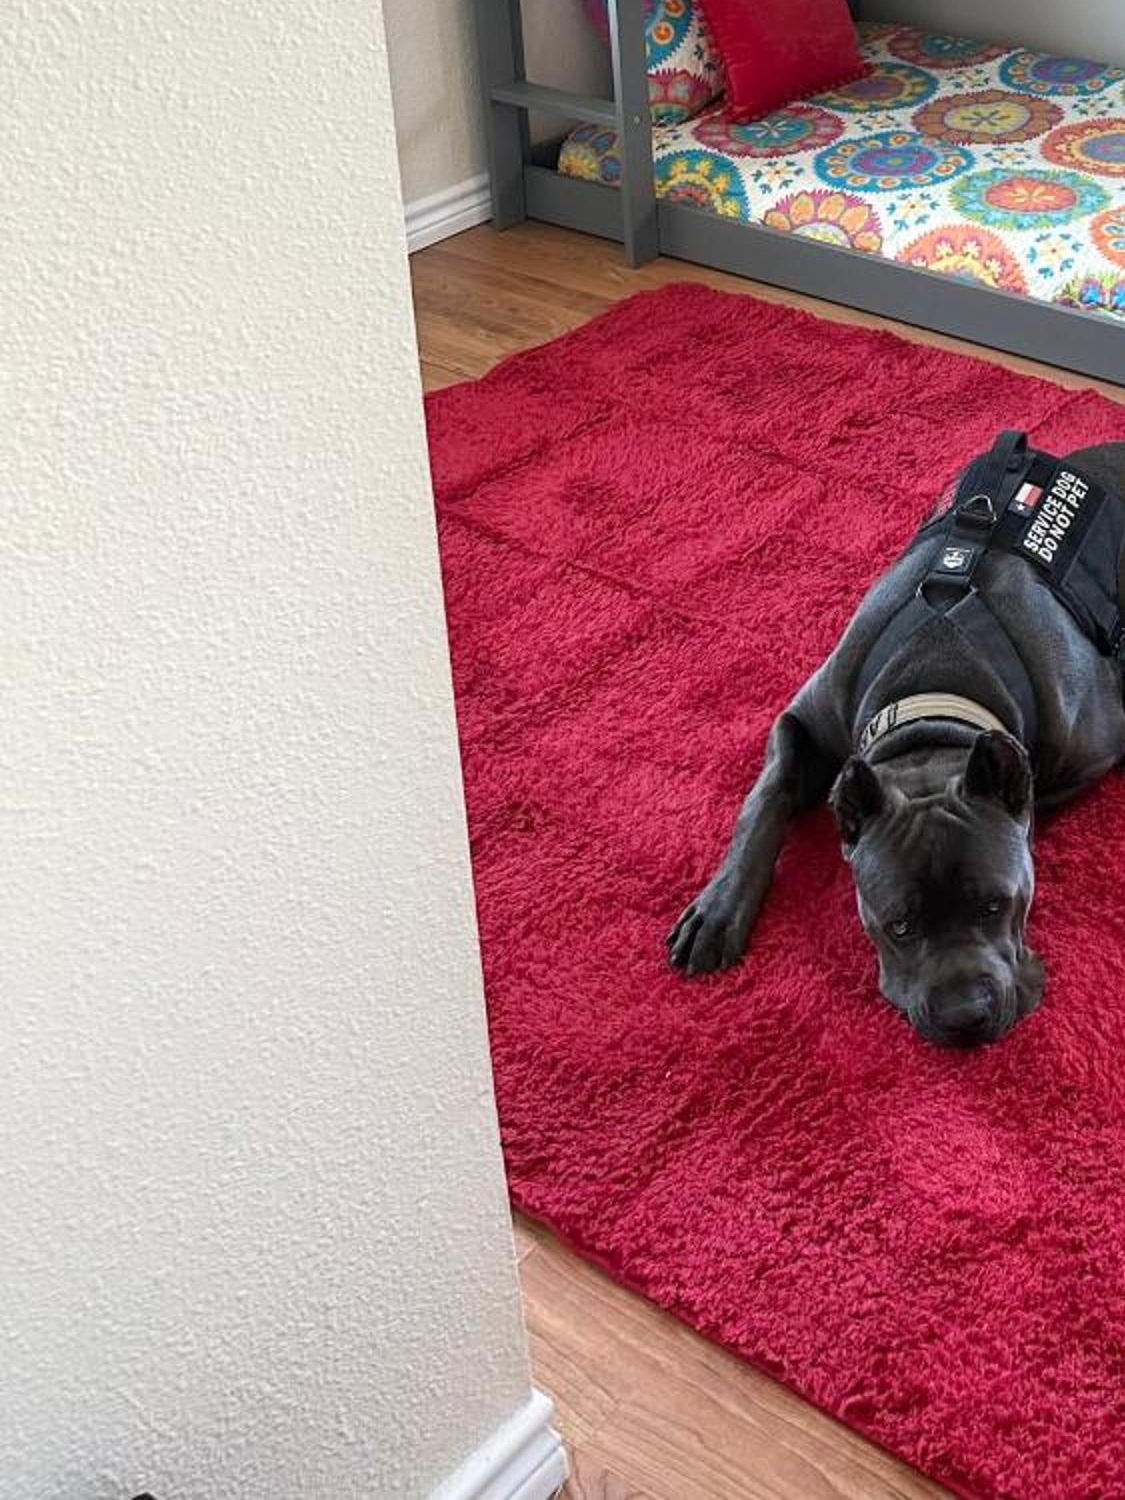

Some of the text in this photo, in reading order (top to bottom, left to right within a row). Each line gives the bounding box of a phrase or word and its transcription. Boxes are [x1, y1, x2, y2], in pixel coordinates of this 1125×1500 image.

[1023, 471, 1077, 552] SERVICE DOG
[1038, 477, 1089, 563] DO NOT PET
